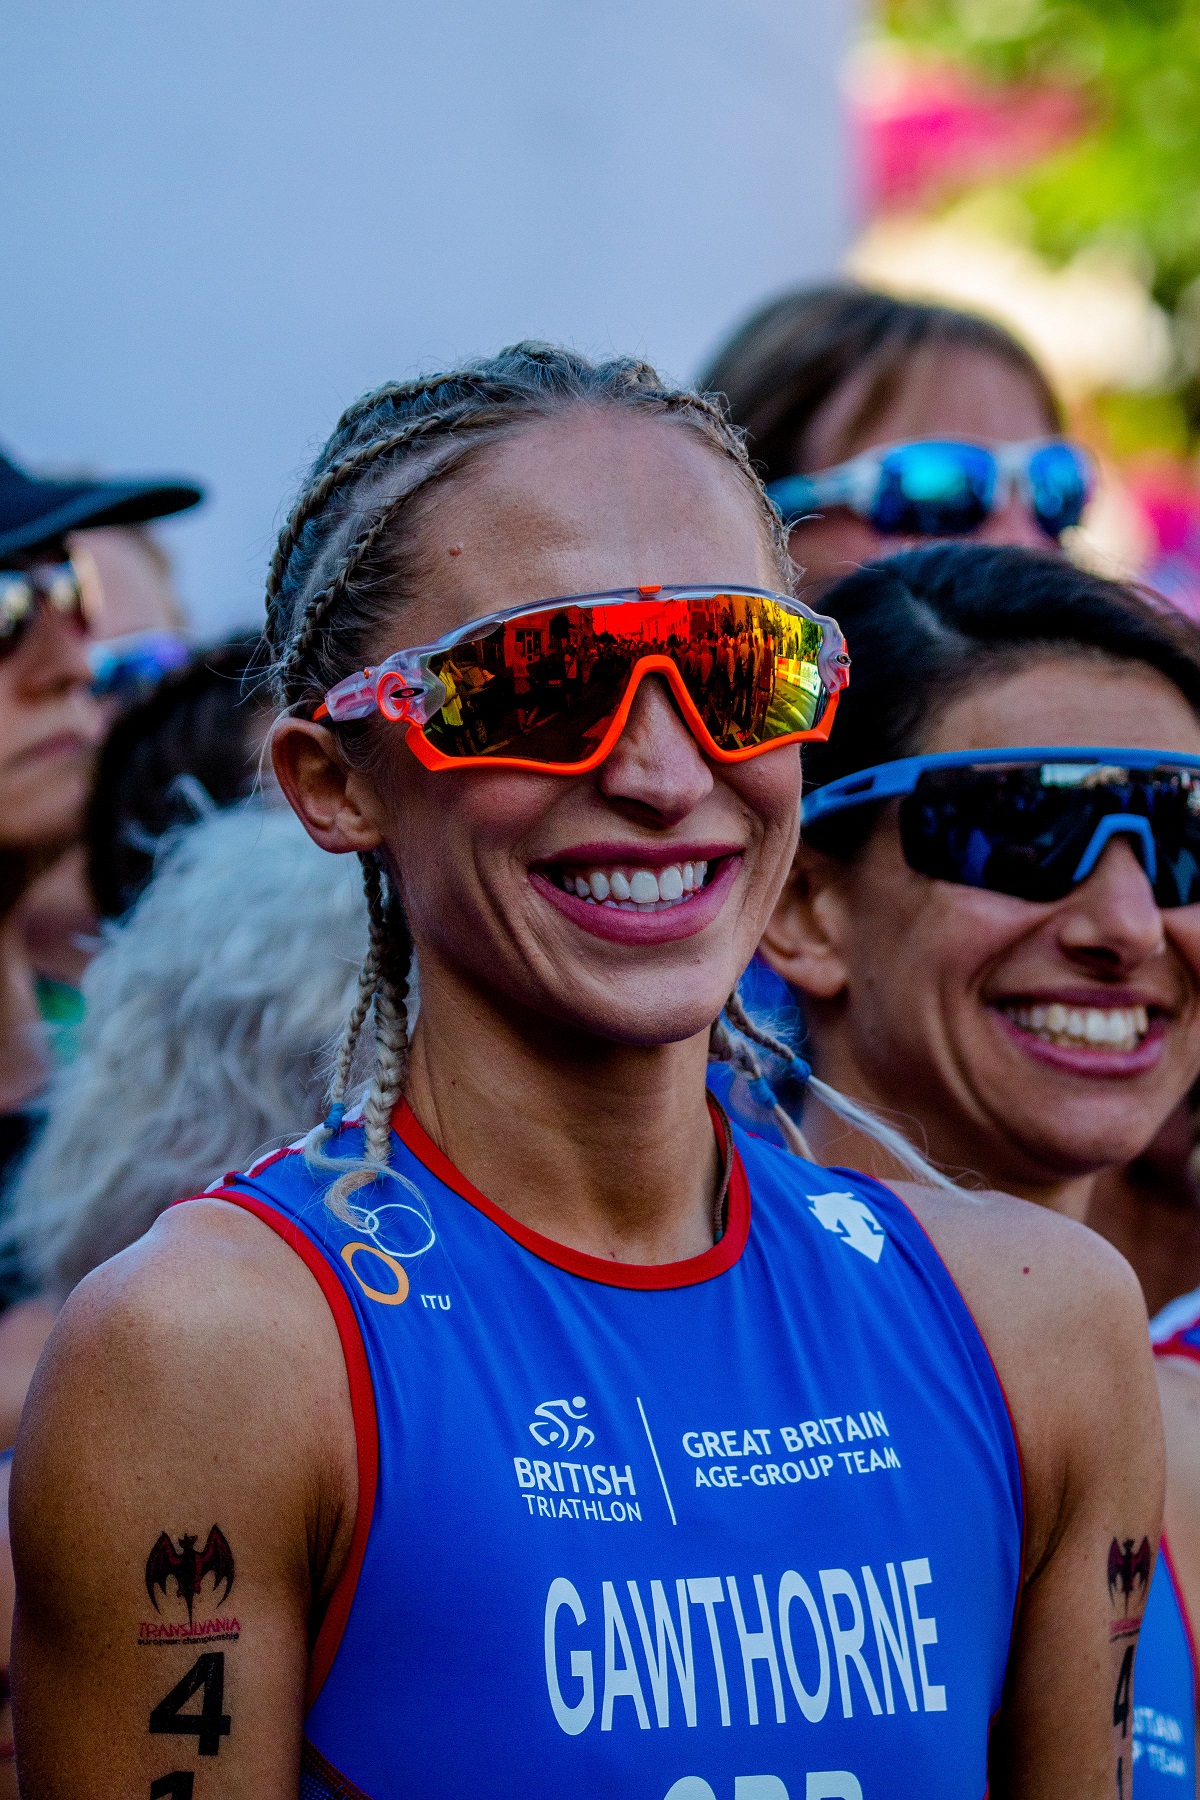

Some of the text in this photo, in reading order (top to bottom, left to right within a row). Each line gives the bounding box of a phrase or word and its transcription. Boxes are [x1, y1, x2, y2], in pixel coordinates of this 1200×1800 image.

[421, 1294, 451, 1311] ITU
[682, 1411, 890, 1458] GREAT BRITAIN
[513, 1457, 637, 1496] BRITISH
[695, 1447, 902, 1488] AGE-GROUP TEAM
[521, 1493, 643, 1522] TRIATHLON
[138, 1617, 241, 1637] TRANSILVANIA
[544, 1557, 948, 1736] GAWTHORNE
[149, 1651, 232, 1756] 4
[1113, 1646, 1133, 1739] 4
